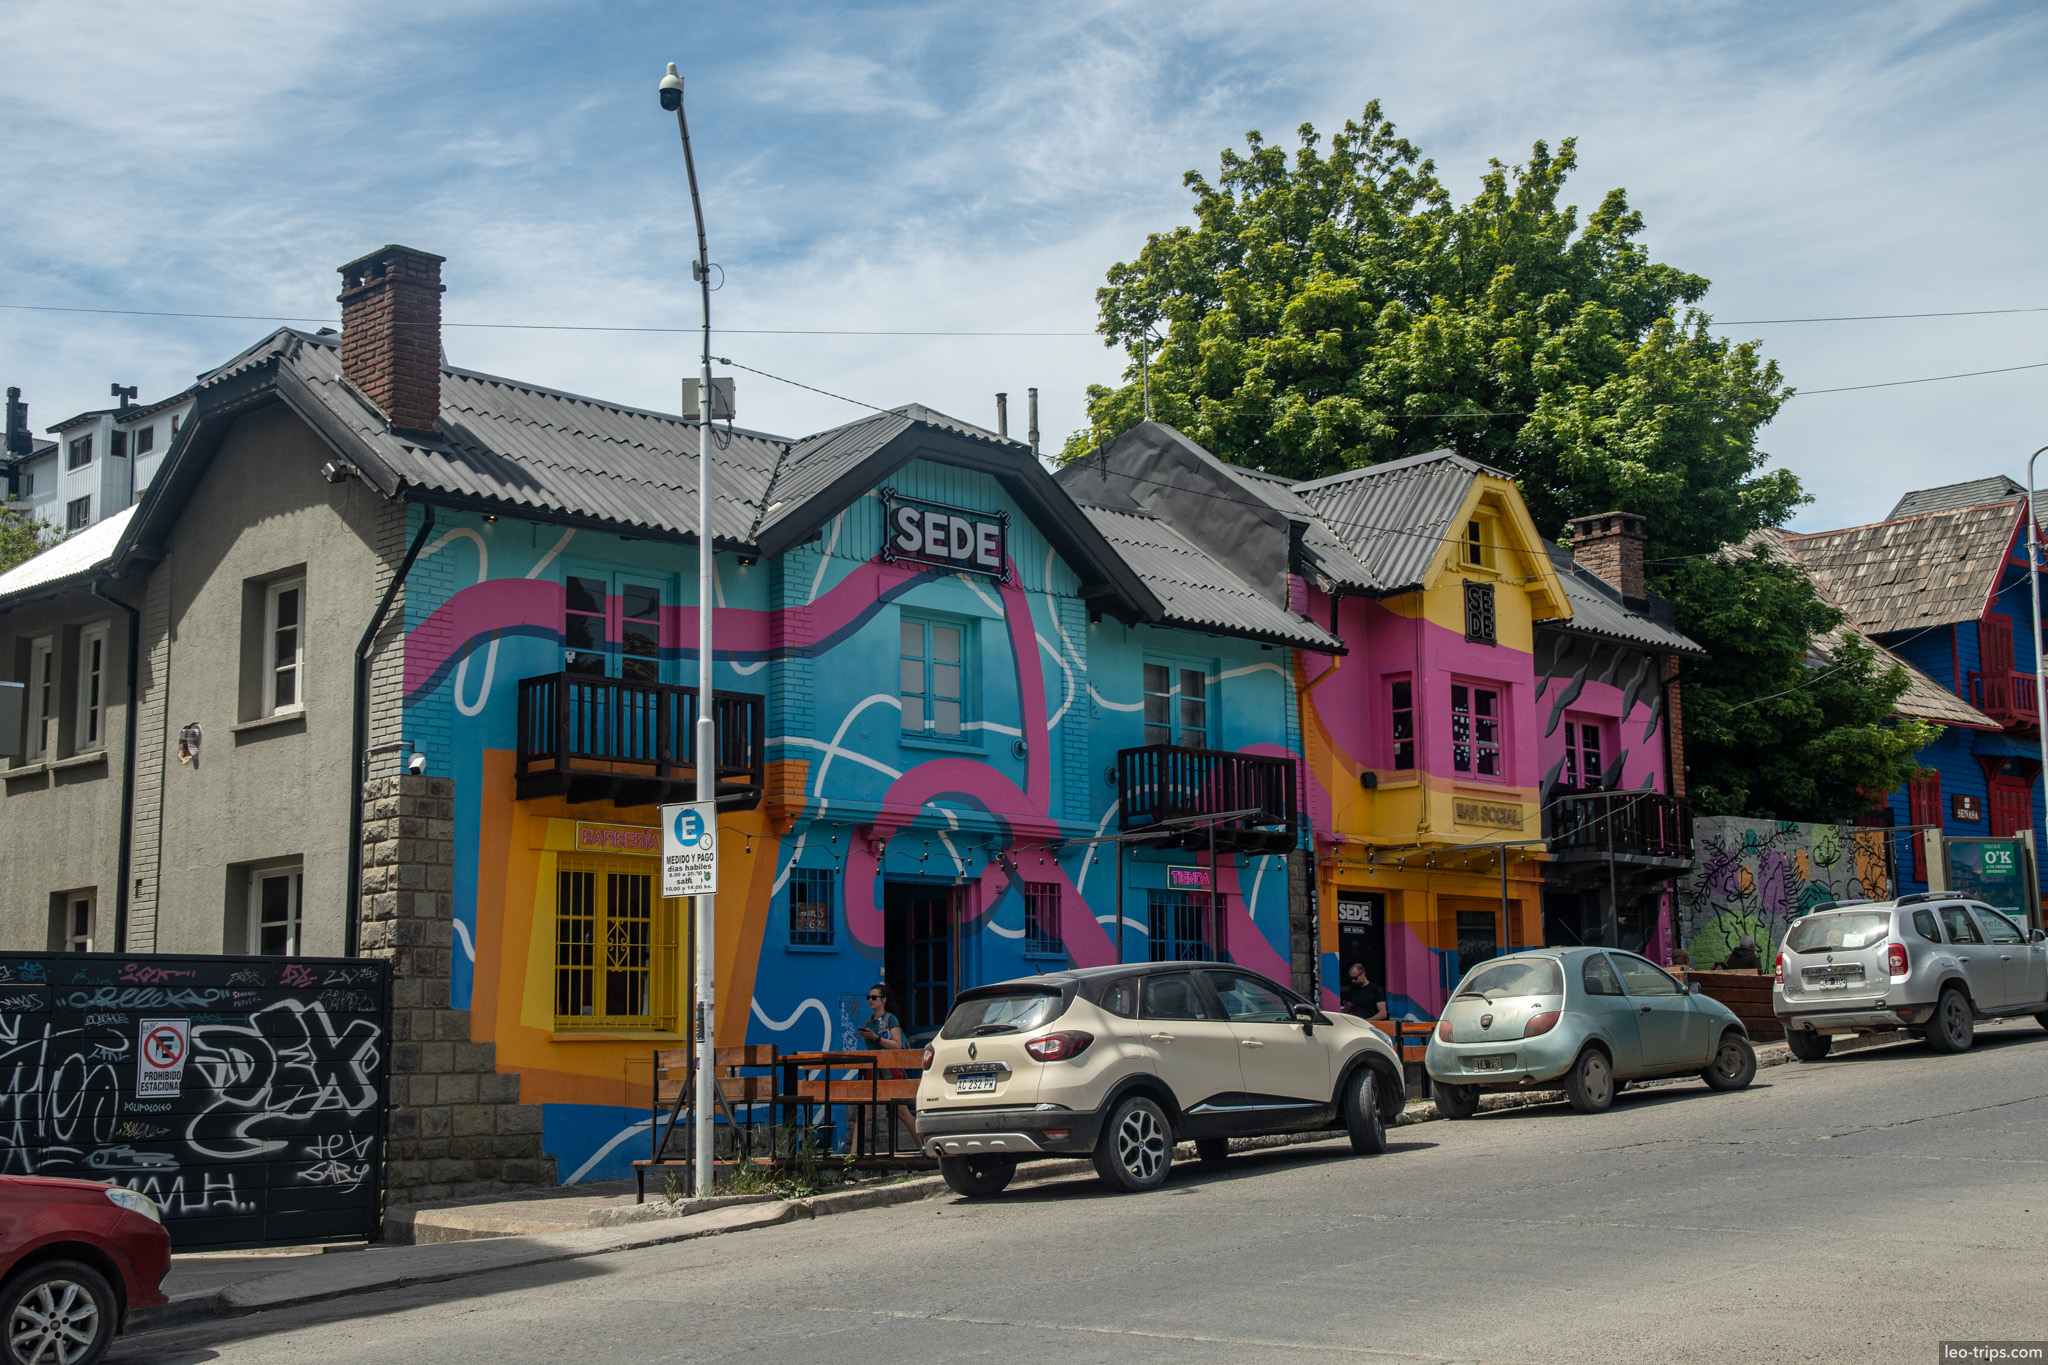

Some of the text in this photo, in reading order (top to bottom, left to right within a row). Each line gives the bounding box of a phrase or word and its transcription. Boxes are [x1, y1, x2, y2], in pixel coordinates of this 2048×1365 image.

[891, 506, 1000, 568] SEDE
[1956, 808, 1979, 820] SENASA
[681, 816, 698, 840] E
[580, 827, 661, 851] BARBERÍA
[666, 852, 714, 865] MEDIDO Y PAGO
[685, 863, 712, 872] habiles
[1171, 870, 1210, 886] TIENDA
[1338, 903, 1370, 922] SEDE
[951, 1063, 997, 1074] CAPTUR
[143, 1070, 182, 1082] PROHIBIDO
[140, 1081, 180, 1093] ESTACIONA
[957, 1080, 967, 1091] AC
[968, 1079, 982, 1090] 232
